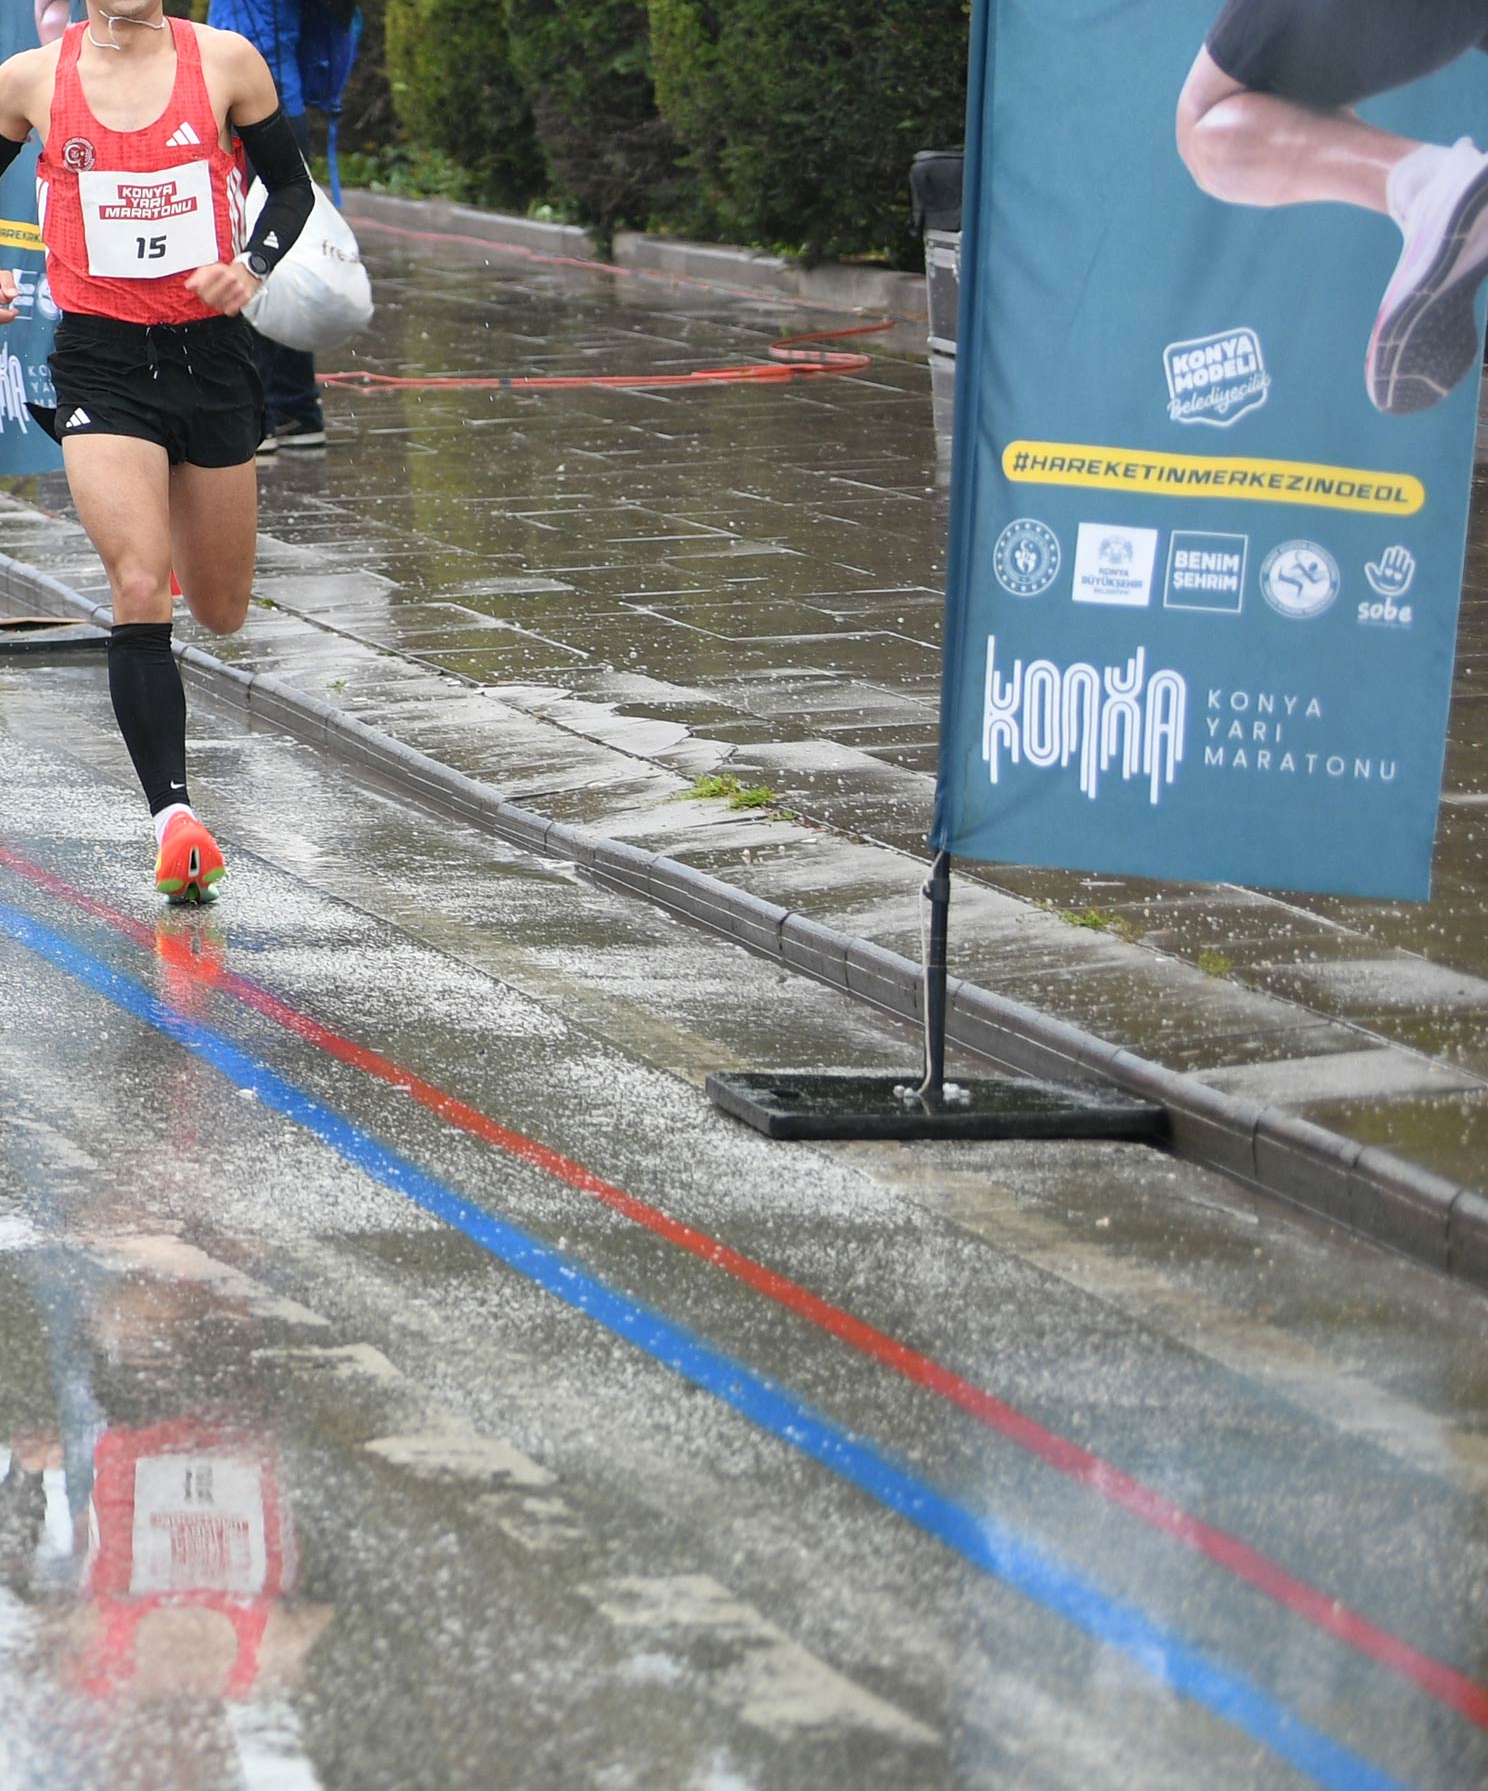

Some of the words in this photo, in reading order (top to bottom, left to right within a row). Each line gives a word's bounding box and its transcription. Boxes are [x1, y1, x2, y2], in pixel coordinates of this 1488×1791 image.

[121, 184, 173, 199] KONYA
[130, 196, 166, 209] YARI
[104, 199, 192, 219] MARATONU
[136, 234, 167, 260] 15
[1172, 334, 1254, 375] KONYA
[1174, 550, 1240, 573] BENİM
[1173, 570, 1238, 593] ŞEHRİM
[1356, 598, 1413, 623] sobe
[1207, 688, 1322, 718] KONYA
[1206, 717, 1282, 743] YARI
[1204, 745, 1397, 781] MARATONU
